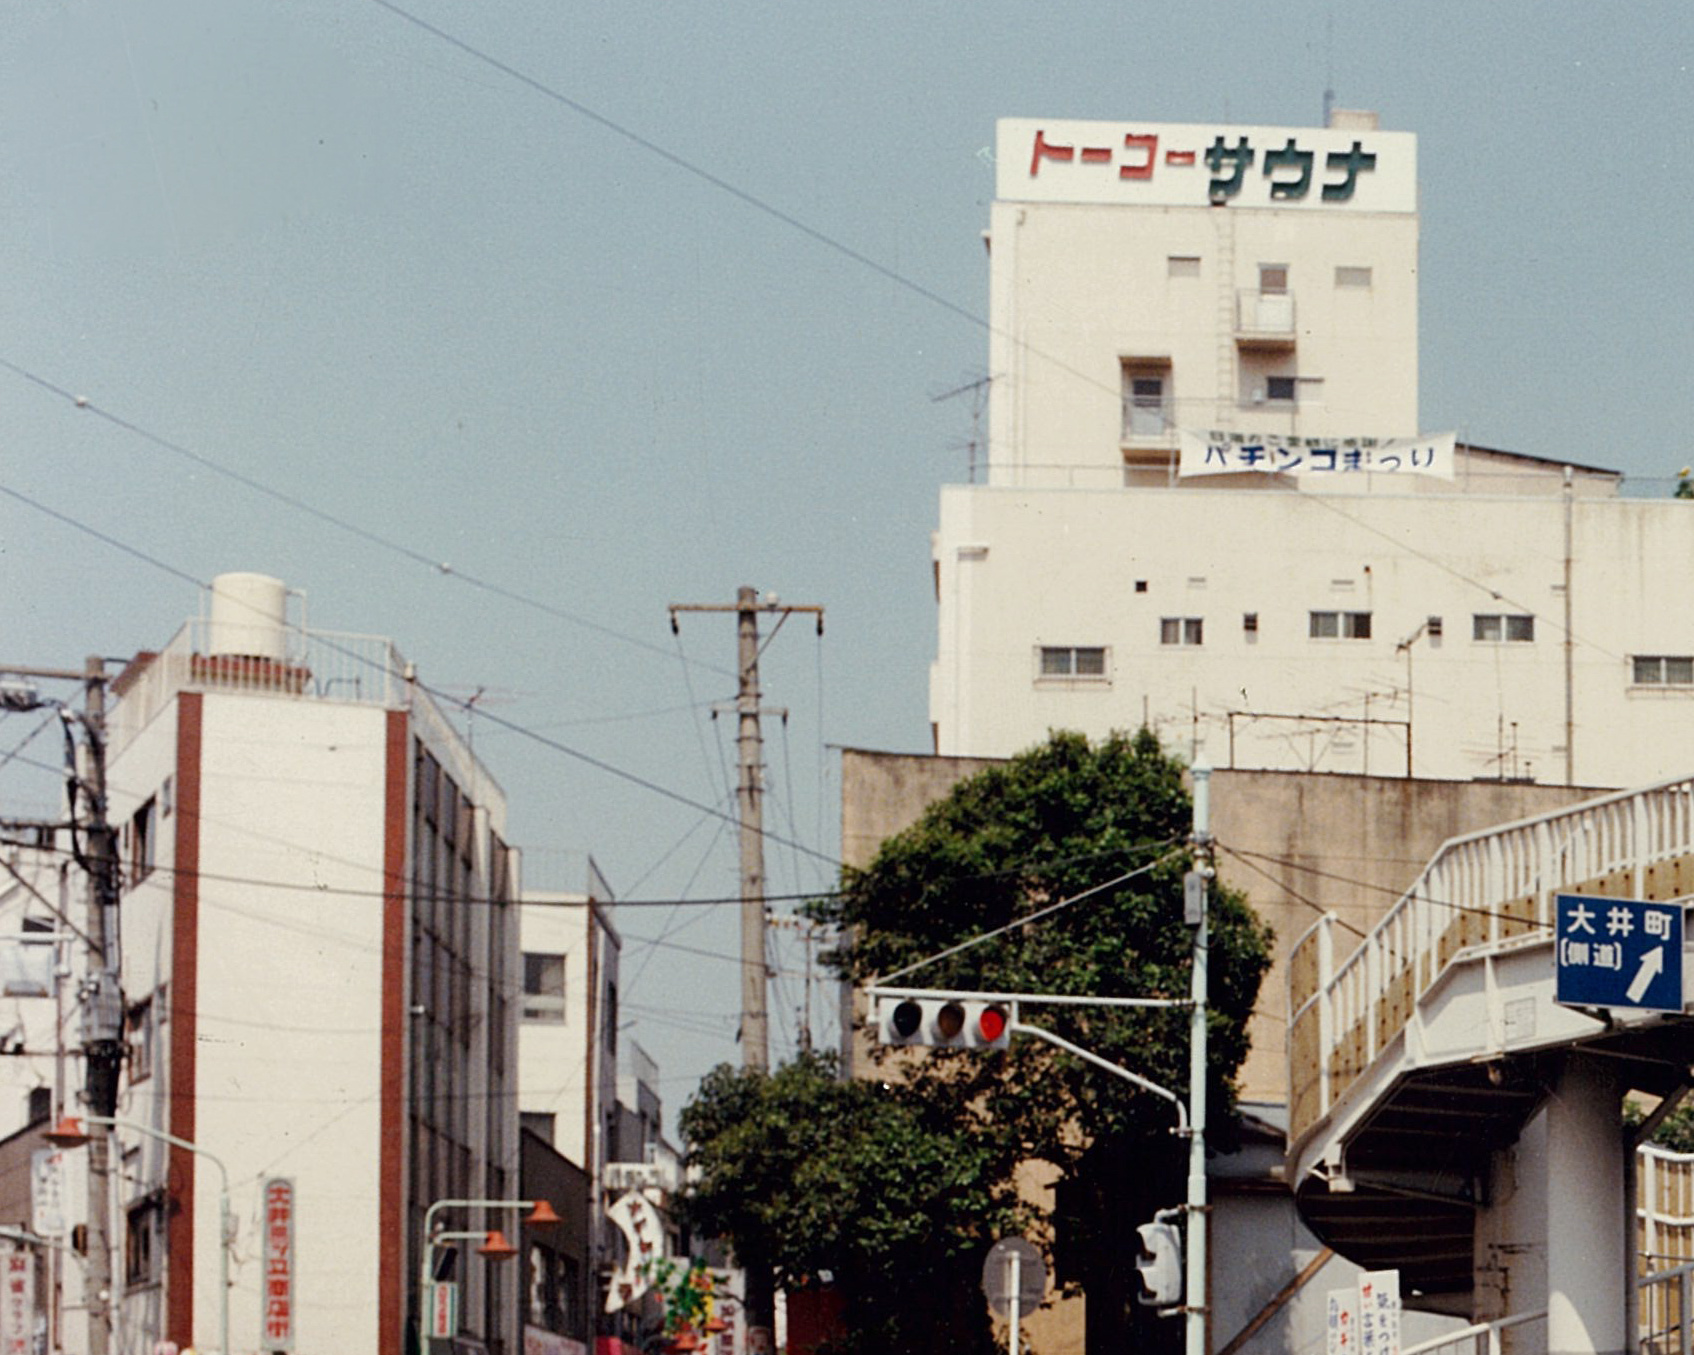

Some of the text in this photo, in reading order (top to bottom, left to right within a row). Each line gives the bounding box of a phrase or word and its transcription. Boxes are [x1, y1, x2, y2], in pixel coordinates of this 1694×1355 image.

[1030, 130, 1377, 202] トーコーサウナ
[1205, 445, 1434, 471] パチンコまつり
[1566, 903, 1673, 941] 大井町
